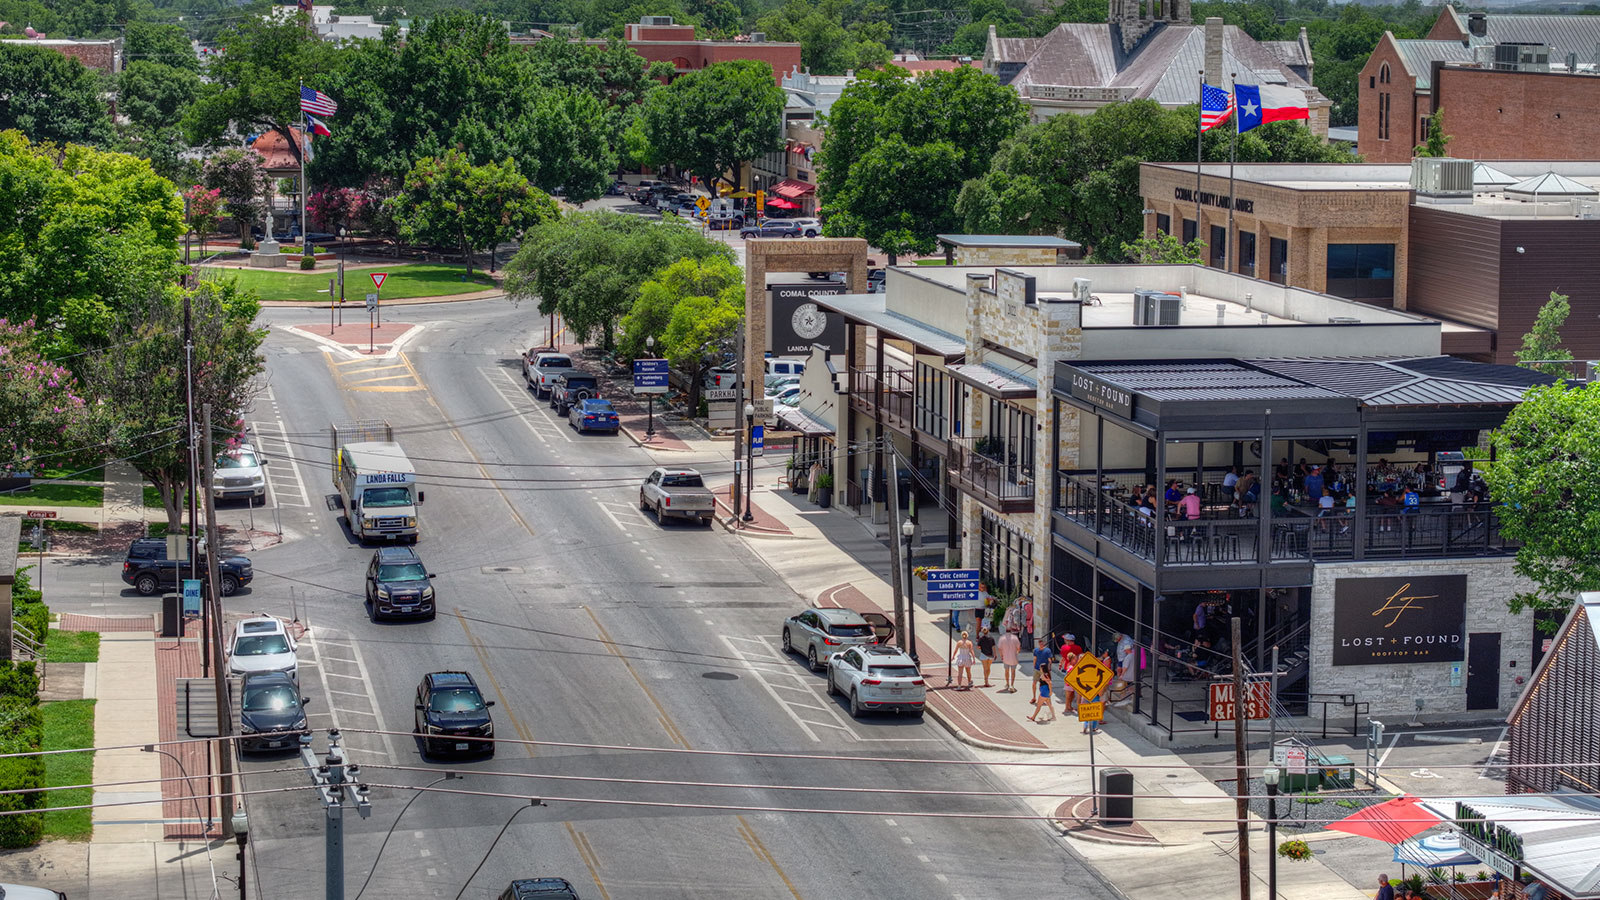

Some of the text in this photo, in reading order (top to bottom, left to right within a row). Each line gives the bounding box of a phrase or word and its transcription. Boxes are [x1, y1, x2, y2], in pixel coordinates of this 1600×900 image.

[780, 289, 839, 298] COMAL COUNTY
[710, 390, 744, 399] PARKHA
[1072, 374, 1094, 392] LOST
[1101, 385, 1130, 407] FOUND
[366, 472, 406, 484] LANDA FALLS
[1408, 497, 1418, 505] 33
[185, 589, 199, 598] DINE
[1341, 637, 1385, 647] LOST
[1403, 634, 1460, 645] FOUND
[1080, 704, 1101, 712] TRAFFIC
[1081, 711, 1099, 719] CIRCLE
[1461, 835, 1475, 853] CRAFT
[1475, 846, 1486, 861] BEER
[1496, 825, 1524, 862] FUSS
